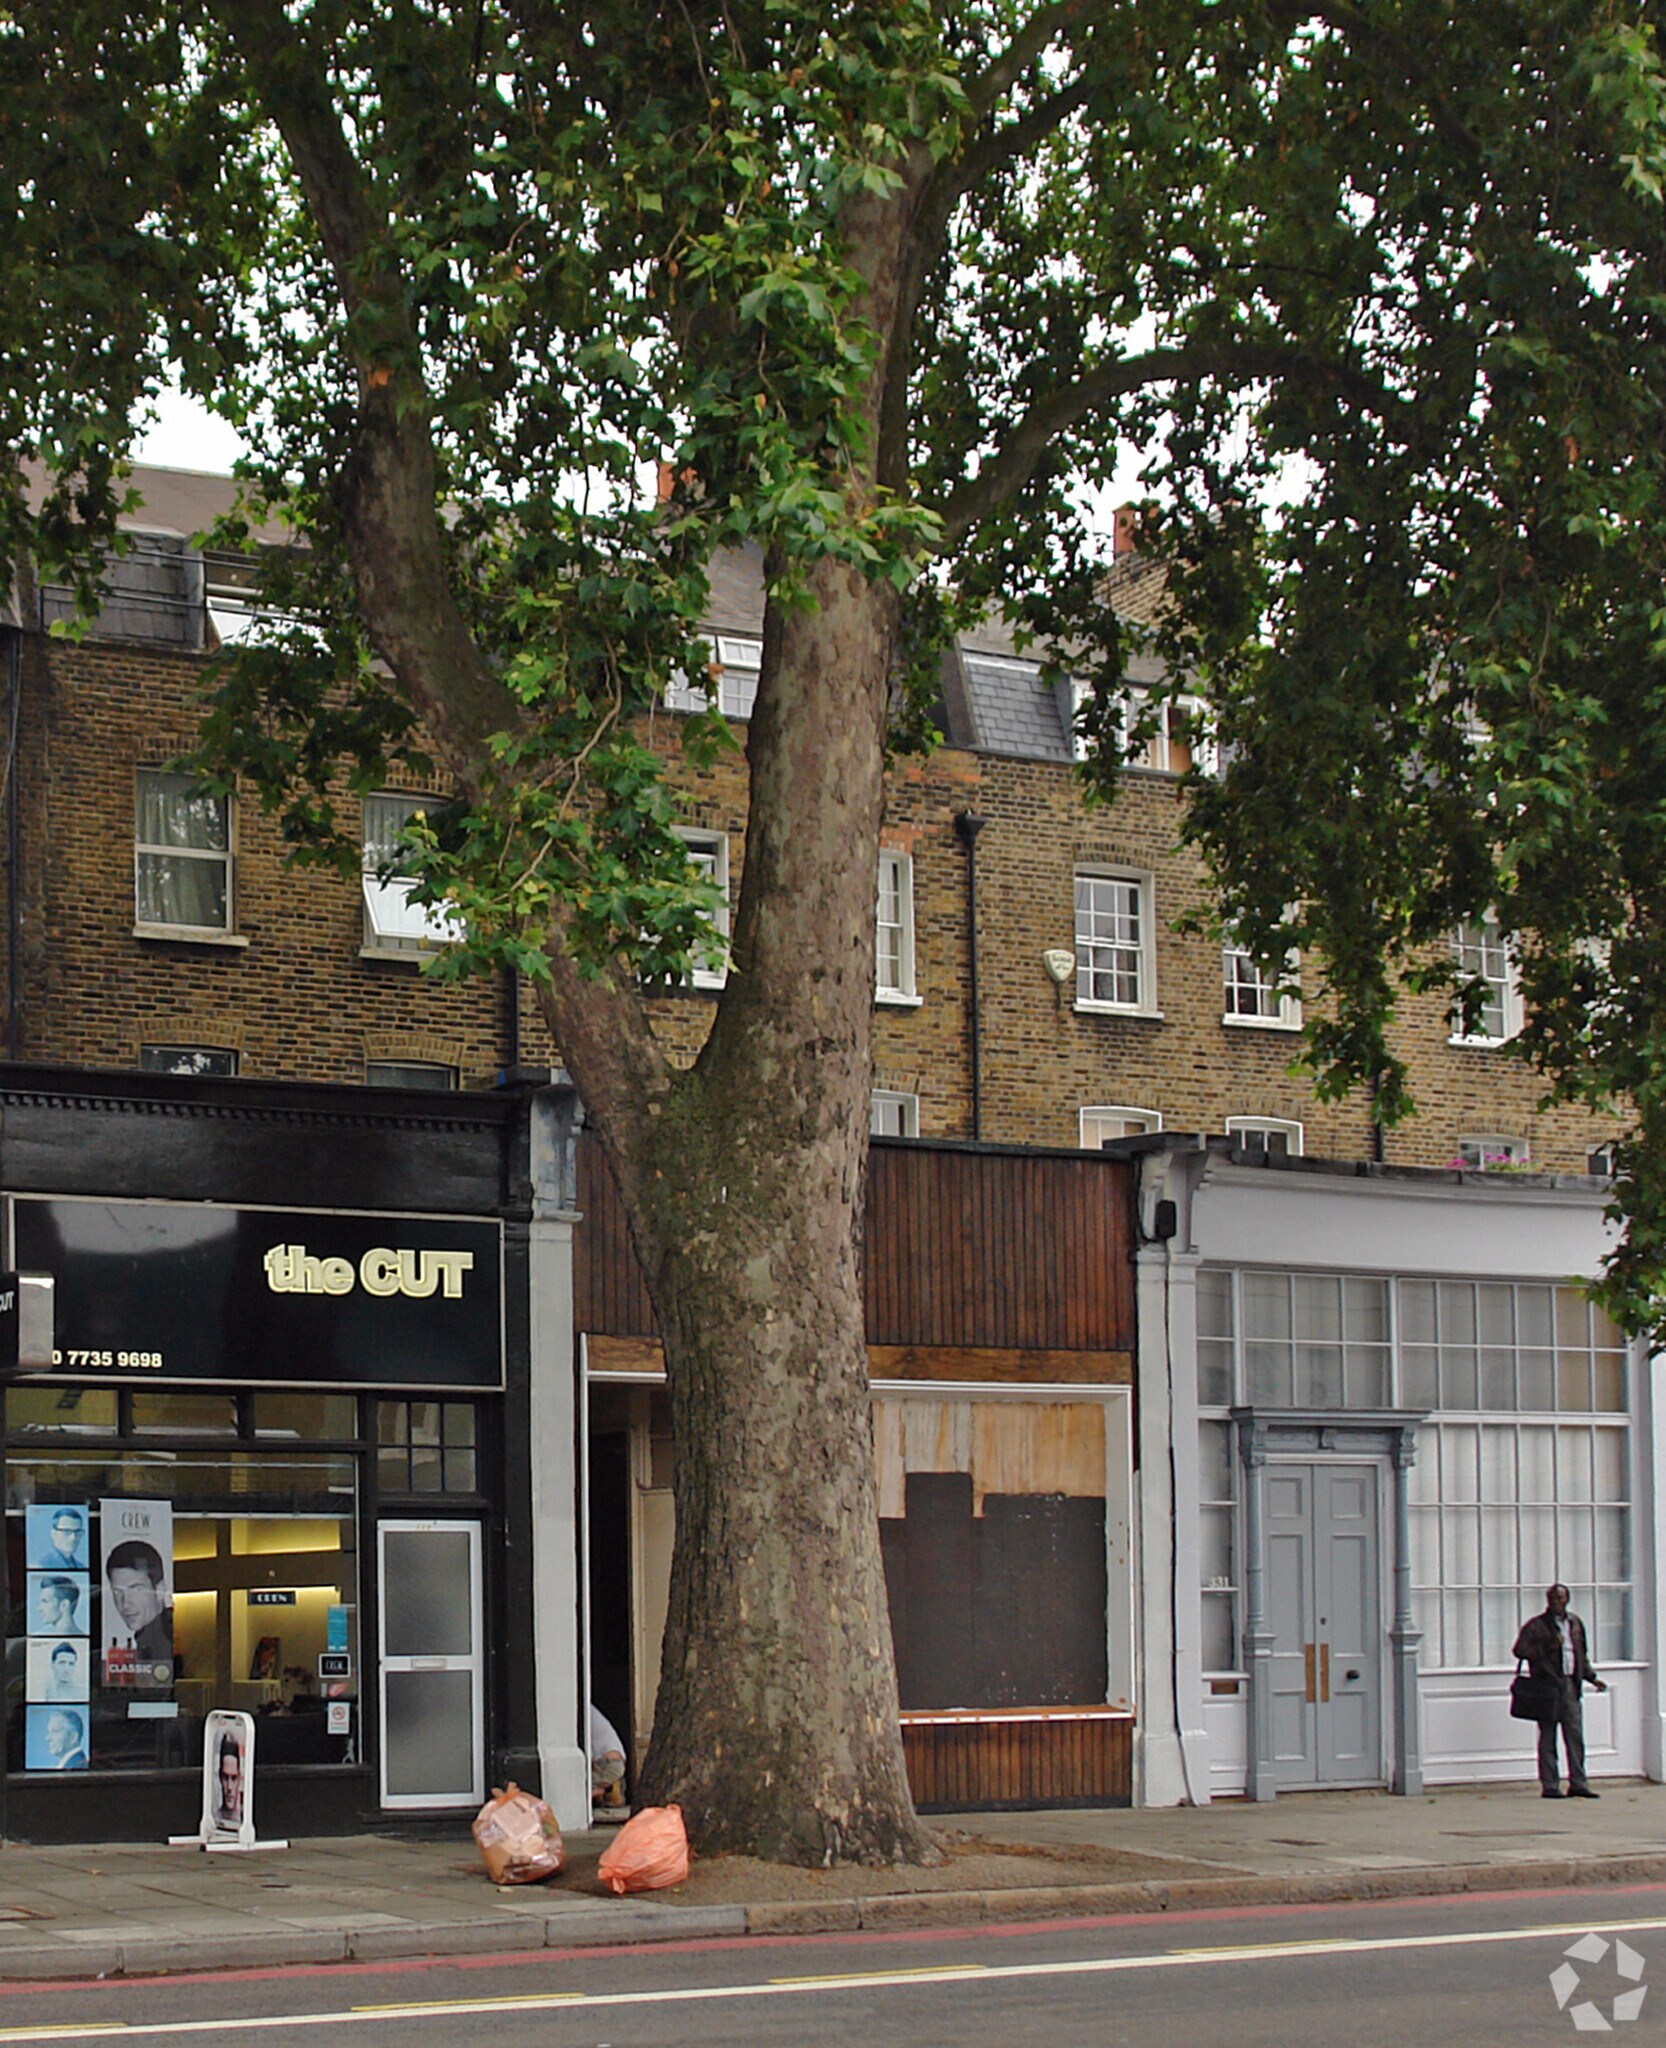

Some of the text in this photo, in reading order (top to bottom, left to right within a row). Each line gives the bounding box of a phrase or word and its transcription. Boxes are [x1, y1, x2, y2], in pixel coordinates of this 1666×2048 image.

[264, 1244, 473, 1298] the CUT
[67, 1351, 112, 1366] 7735
[117, 1352, 162, 1368] 9698
[121, 1511, 151, 1529] CREW
[109, 1664, 152, 1673] CLASSIC
